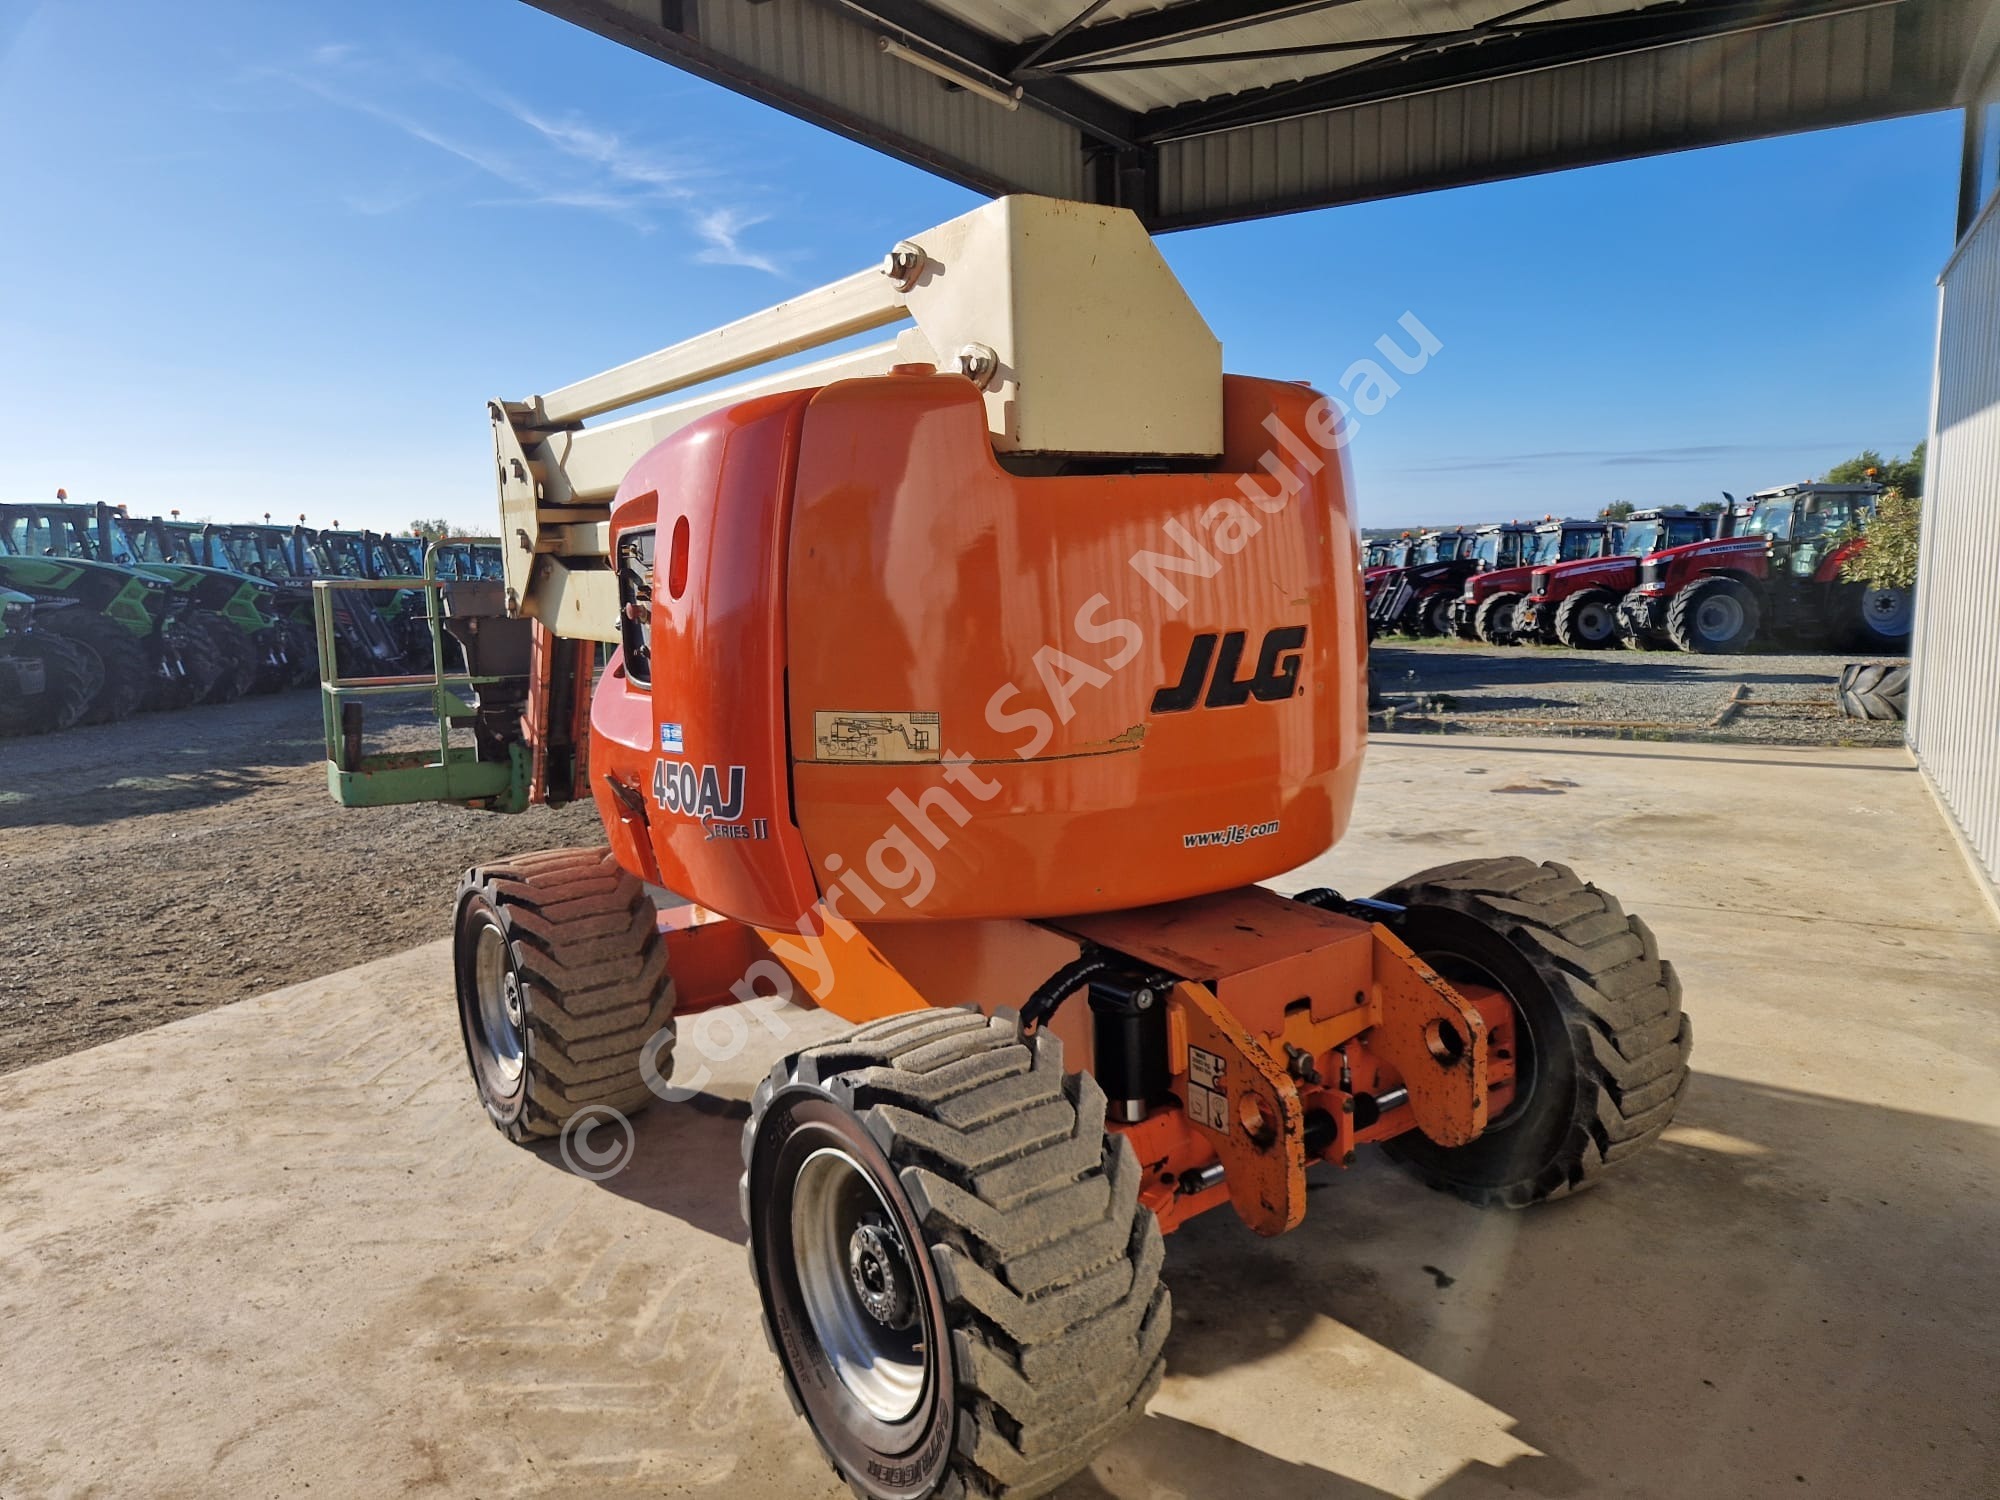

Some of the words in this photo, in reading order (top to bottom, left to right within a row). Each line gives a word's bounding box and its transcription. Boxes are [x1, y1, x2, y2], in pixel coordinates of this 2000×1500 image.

[284, 580, 305, 588] MX
[1150, 625, 1307, 714] JLG
[652, 757, 746, 821] 450AJ
[701, 813, 750, 841] SERIES
[1184, 819, 1280, 848] www.jlg.com
